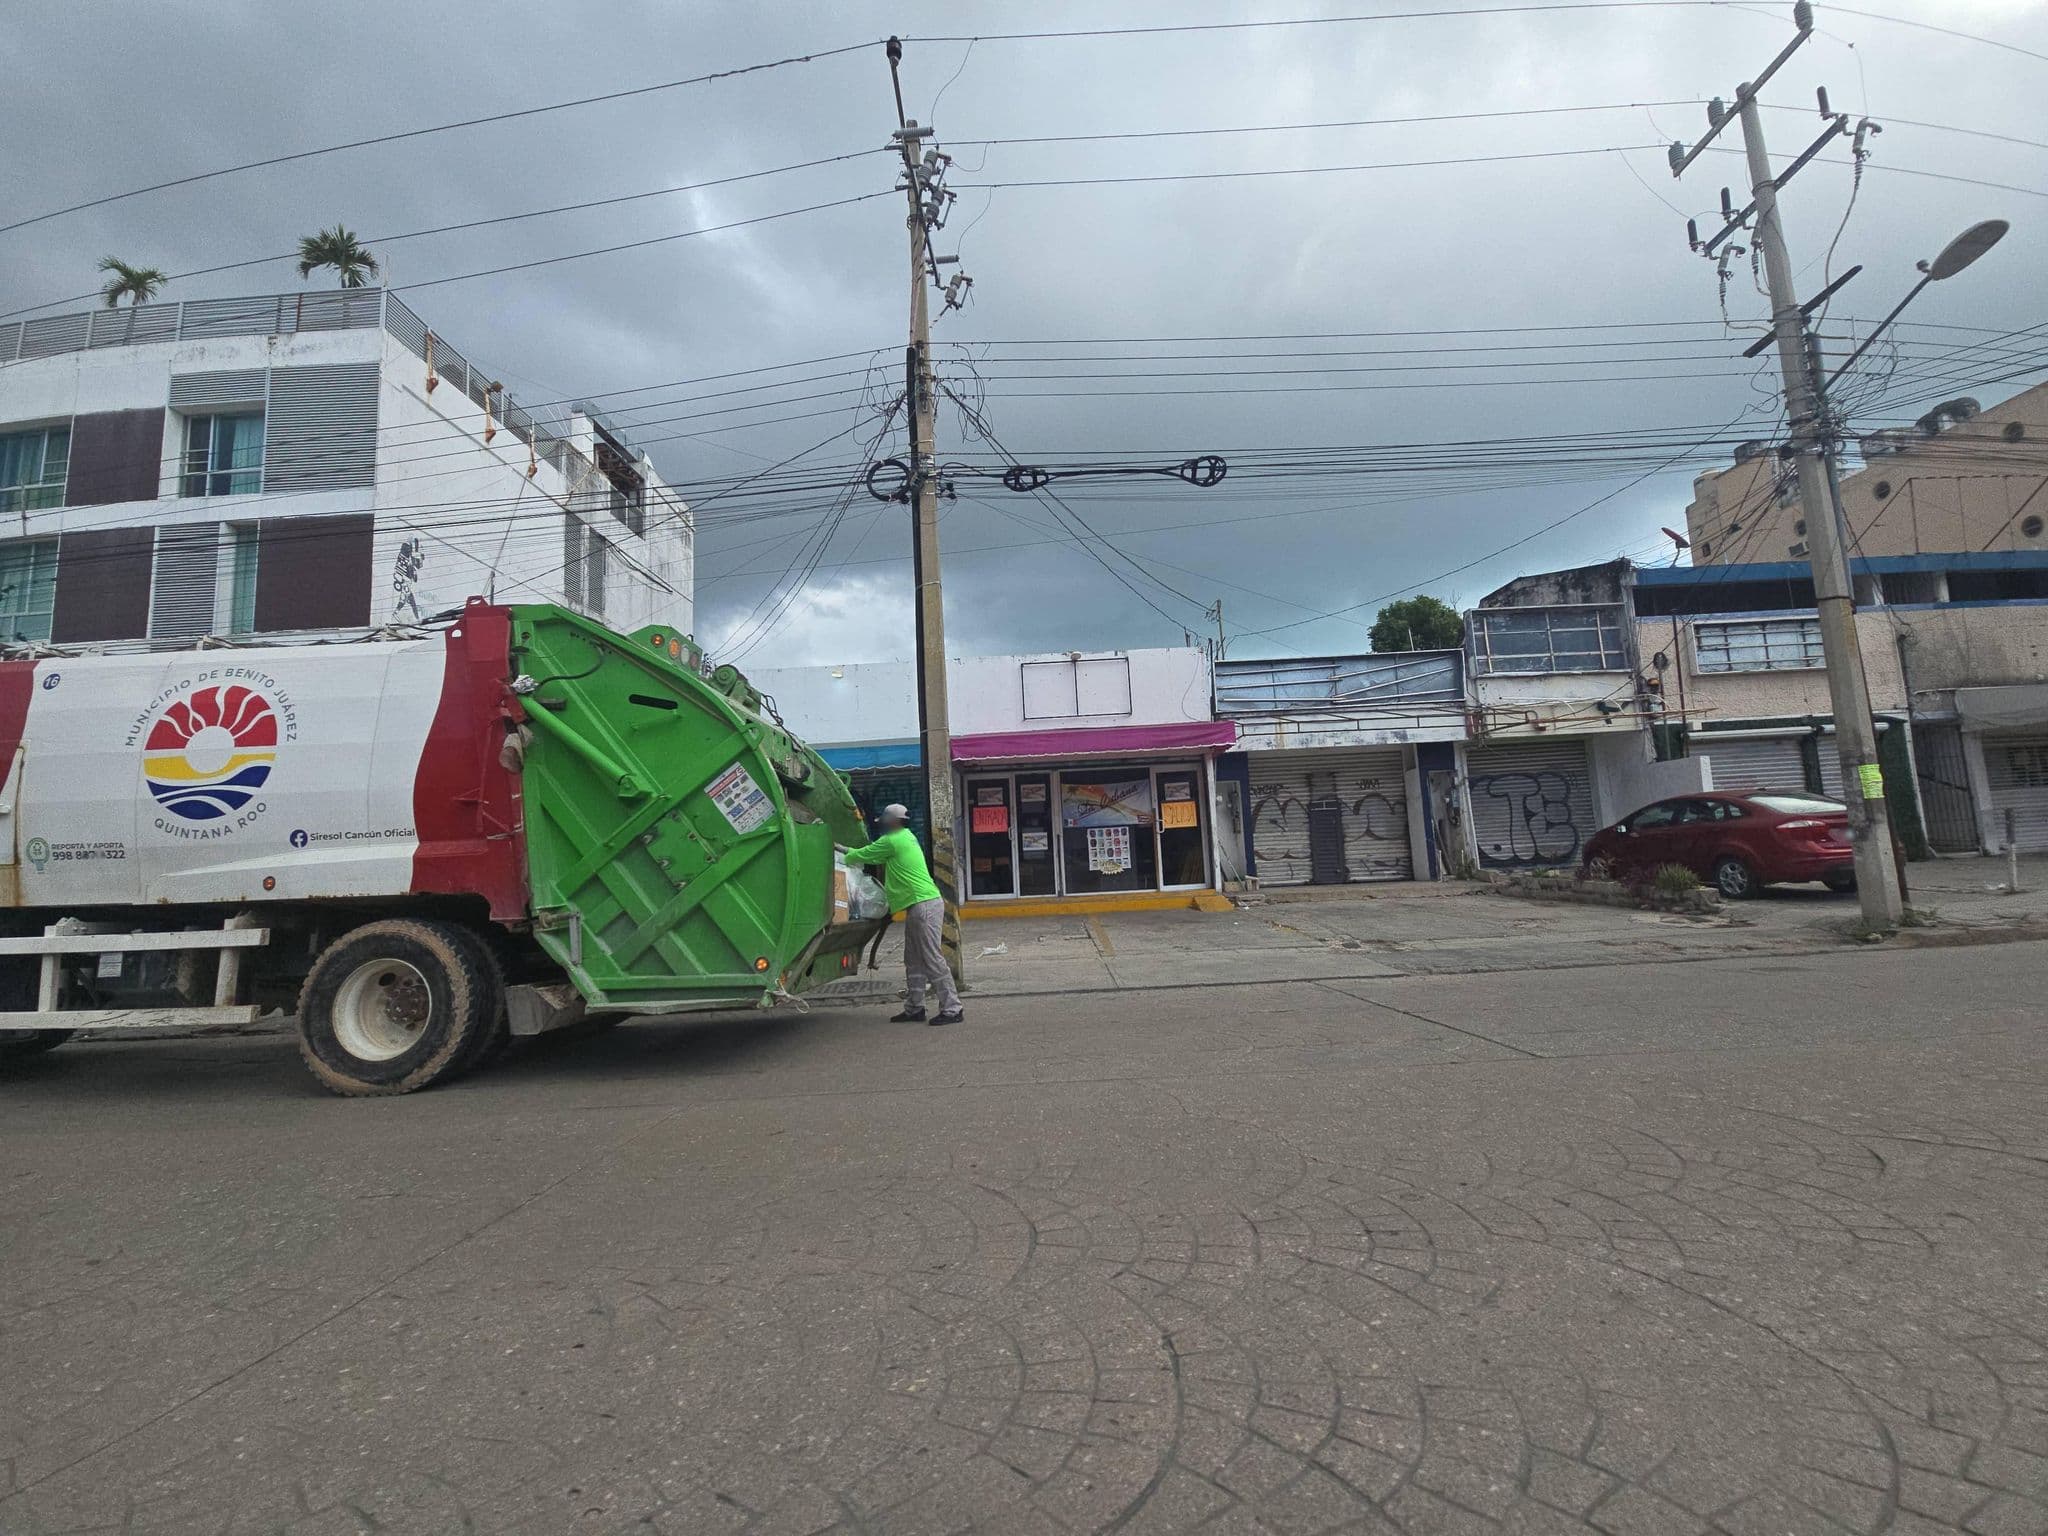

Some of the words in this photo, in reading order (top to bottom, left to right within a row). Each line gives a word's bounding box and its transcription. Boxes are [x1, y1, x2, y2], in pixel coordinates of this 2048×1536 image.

[125, 679, 191, 747] MUNICIPIO
[198, 669, 219, 682] DE
[224, 668, 276, 688] BENITO
[273, 689, 297, 742] JUÁREZ
[154, 818, 233, 839] QUINTANA
[237, 802, 267, 829] ROO
[310, 832, 342, 841] Siresol
[344, 830, 382, 840] Cancún
[384, 828, 416, 838] Oficial
[52, 851, 73, 861] 998
